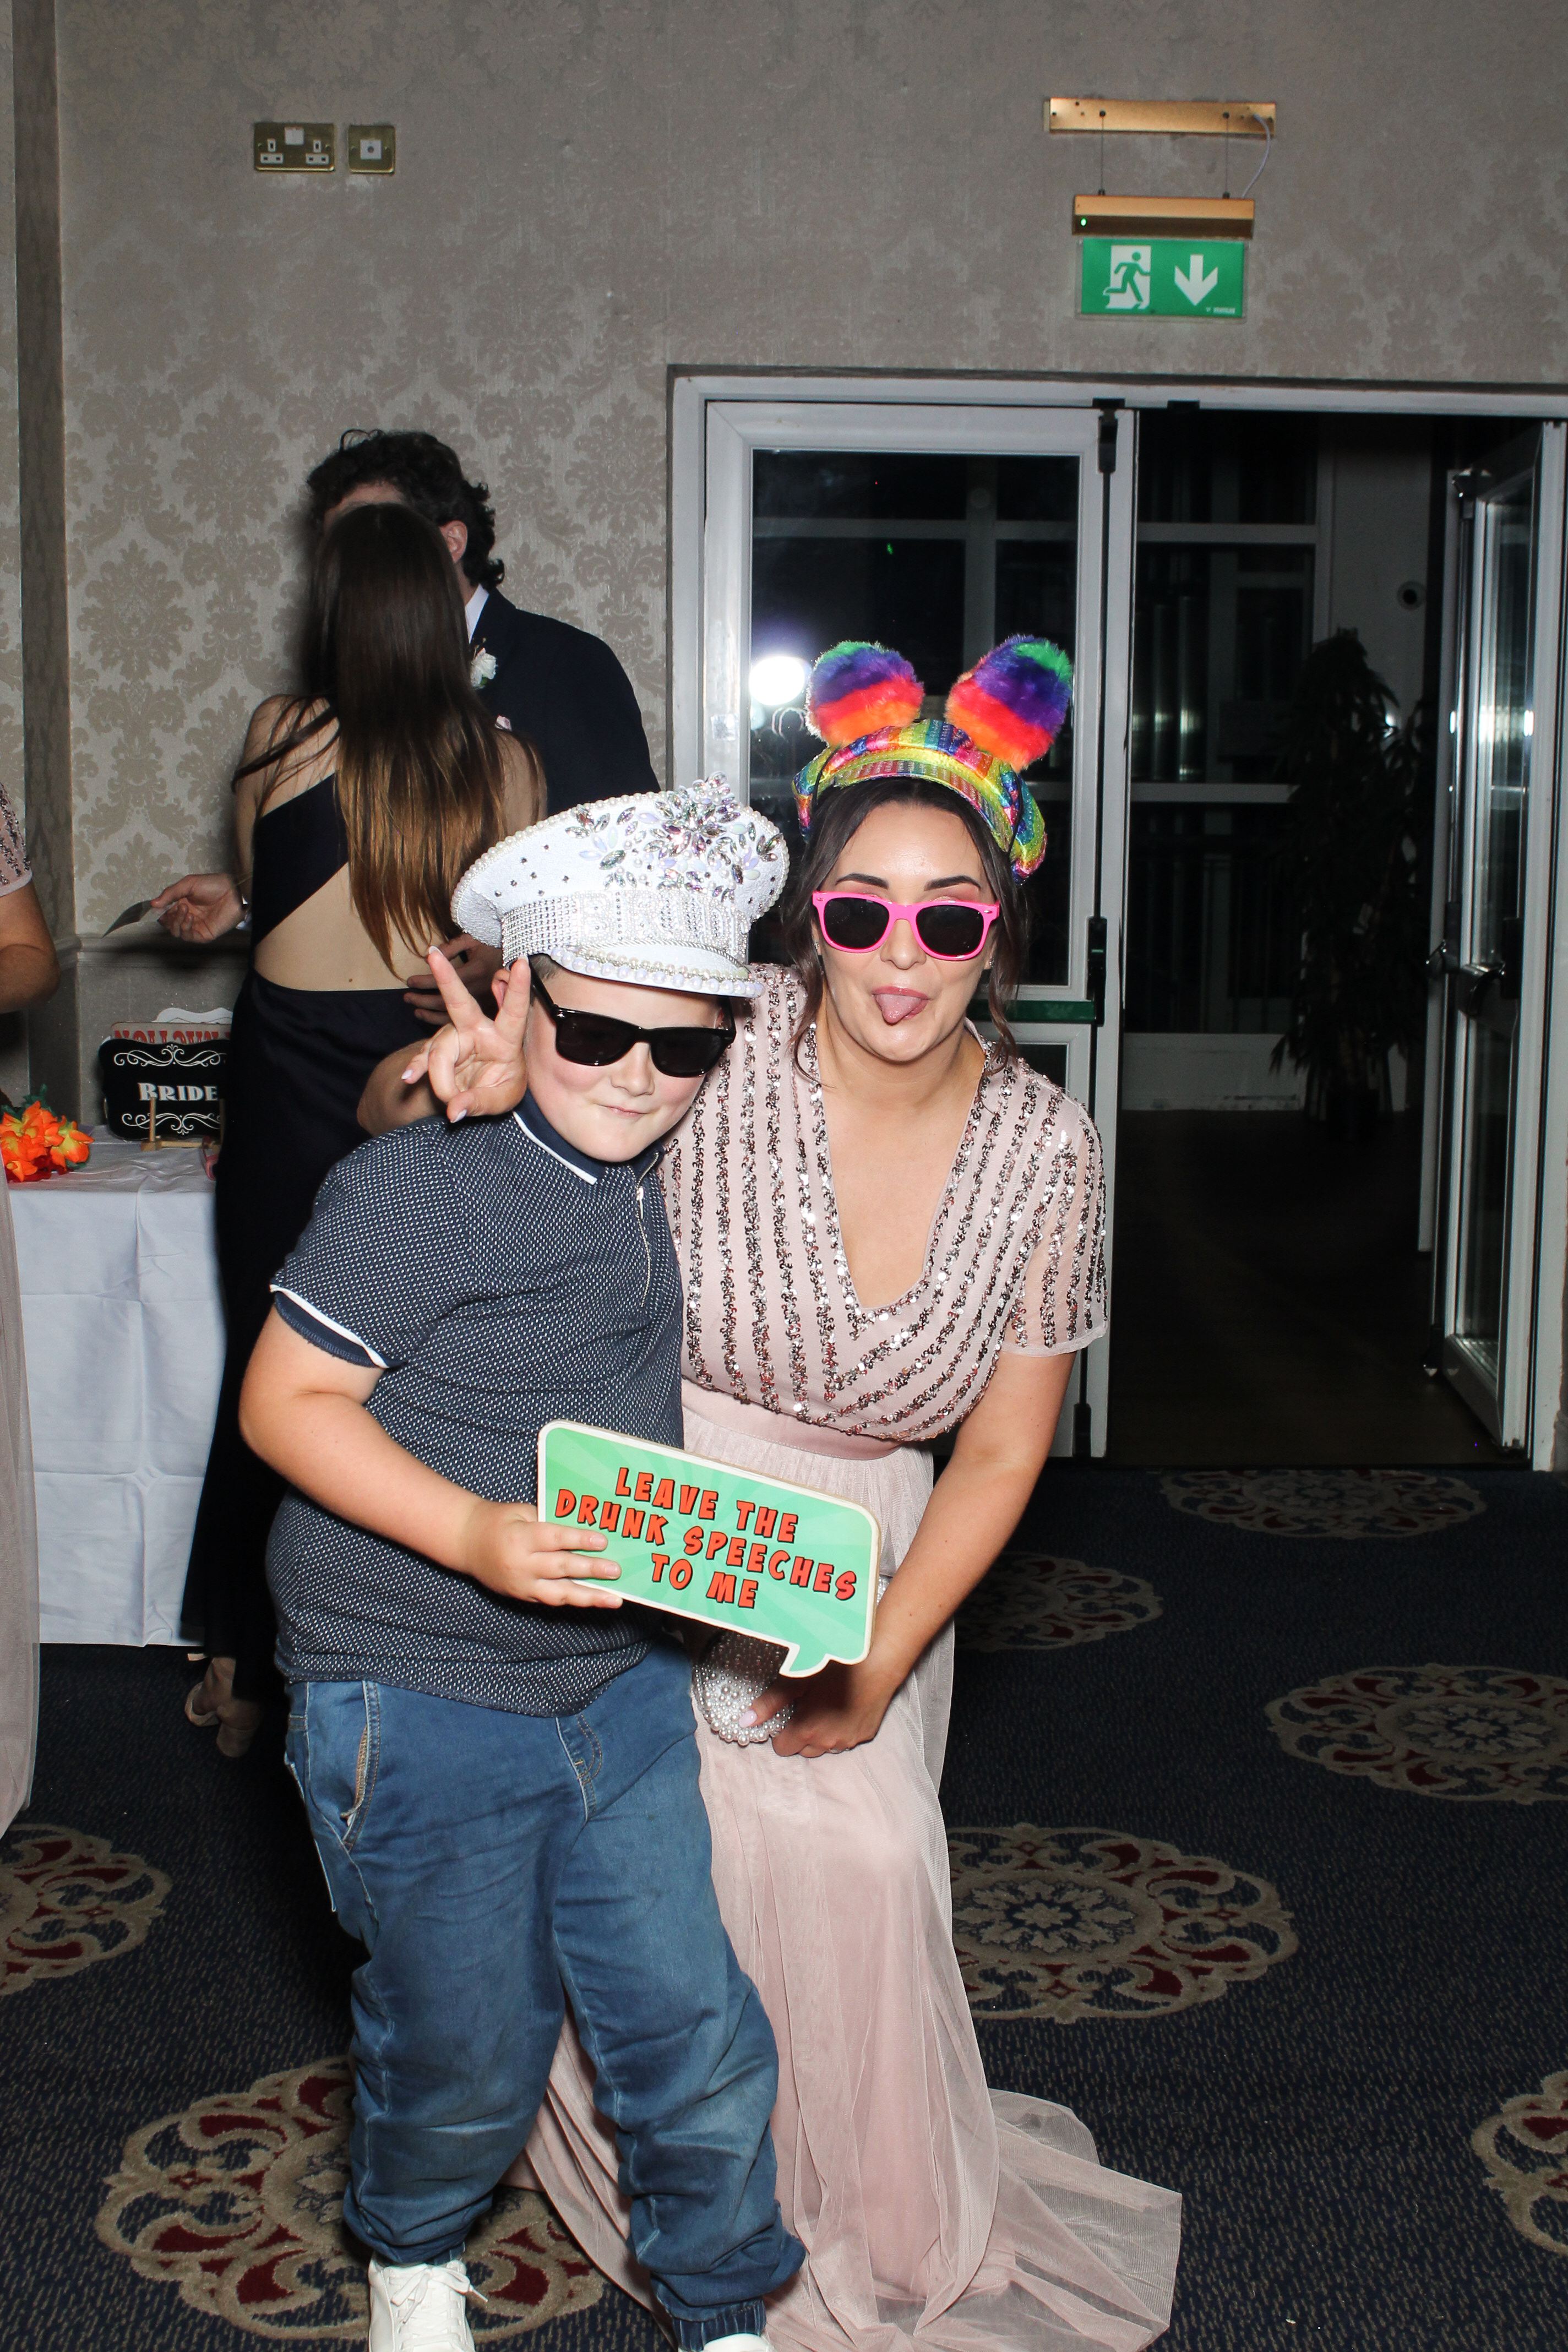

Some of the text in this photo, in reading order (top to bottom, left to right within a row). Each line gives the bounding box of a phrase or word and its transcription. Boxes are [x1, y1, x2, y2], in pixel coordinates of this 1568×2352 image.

[615, 1467, 798, 1543] LEAVE THE
[555, 1489, 857, 1600] DRUNK SPEECHES
[651, 1553, 758, 1609] TO ME
